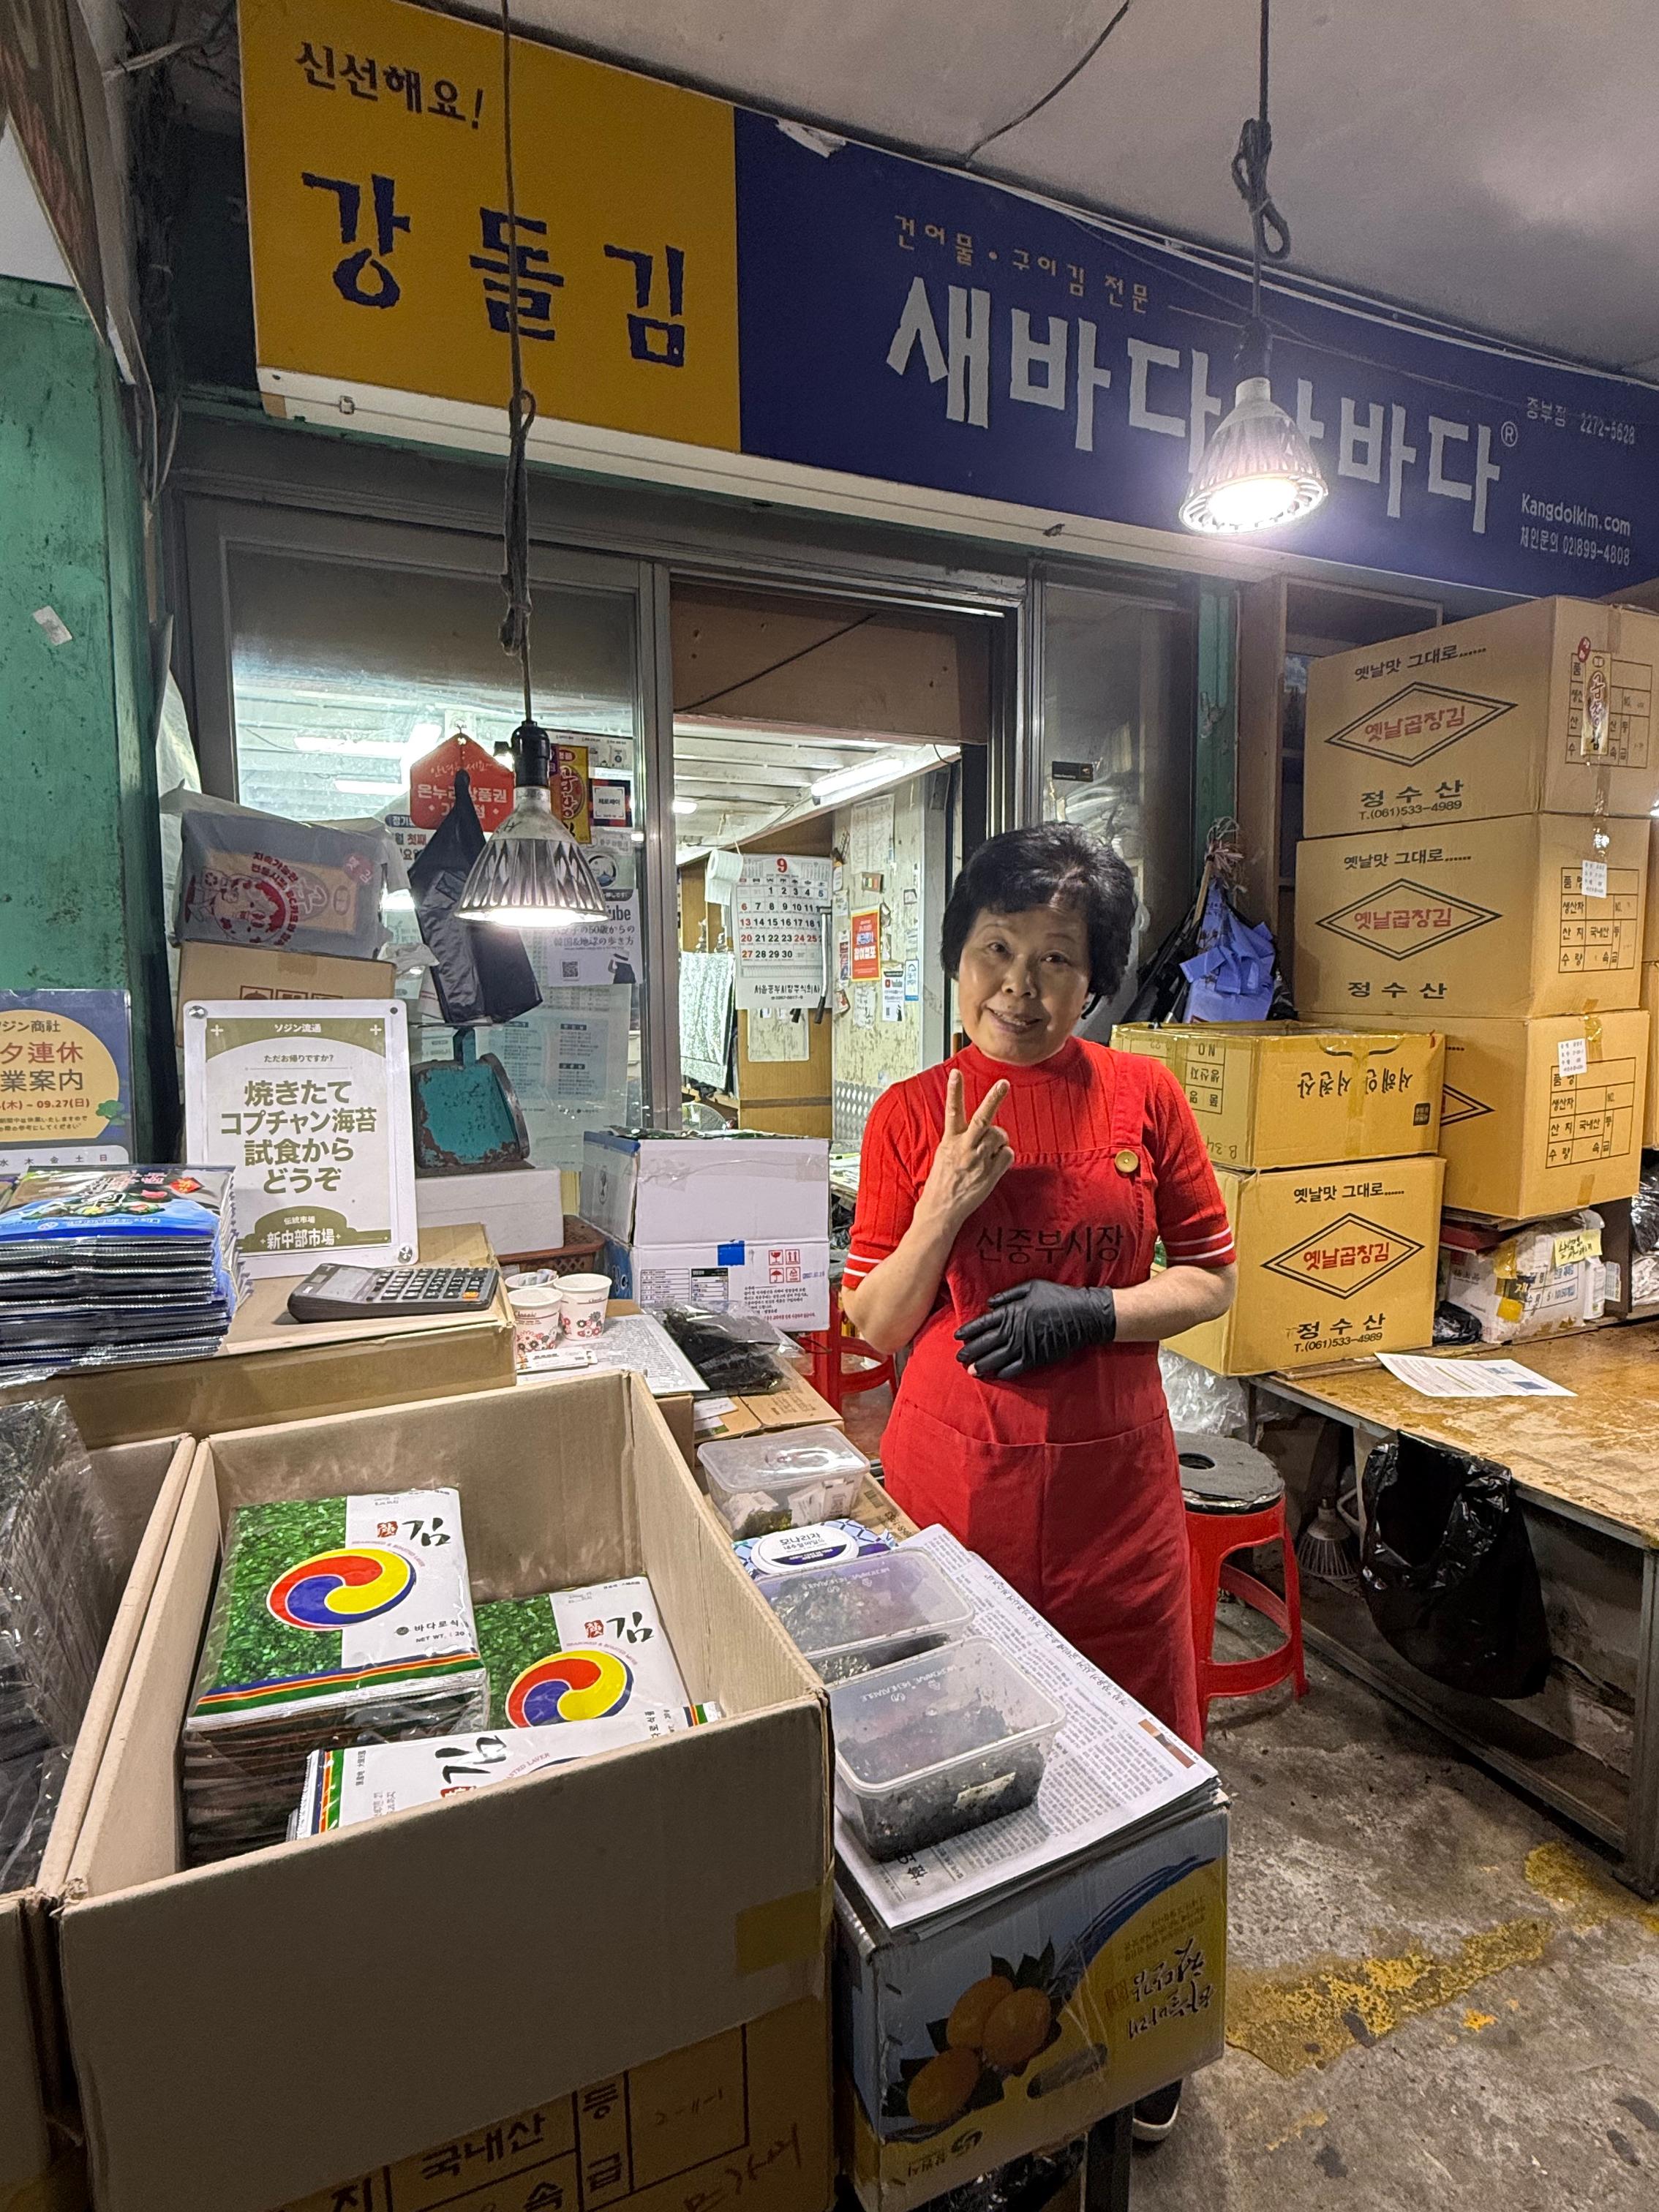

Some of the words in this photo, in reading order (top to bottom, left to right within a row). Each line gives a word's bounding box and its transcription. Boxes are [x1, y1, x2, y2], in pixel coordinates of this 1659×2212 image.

[296, 41, 484, 129] 신선해요!
[1104, 274, 1148, 315] 전문
[886, 276, 1222, 474] 새바다
[1354, 660, 1402, 682] 옛날맛
[1364, 706, 1467, 743] 옛날곱창김
[777, 858, 787, 873] 9
[1344, 854, 1389, 870] 옛날맛
[1353, 907, 1453, 930] 옛날곱창김
[274, 1023, 322, 1034] ソジン流通
[244, 1079, 353, 1107] 焼きたて
[221, 1107, 377, 1136] コプチャン海苔
[99, 1154, 108, 1162] 日
[244, 1136, 355, 1167] 試食から
[263, 1166, 342, 1195] どうぞ
[1293, 1185, 1338, 1204] 옛날맛
[283, 1215, 316, 1225] 伝統市場
[266, 1227, 336, 1250] 新中部市場
[975, 1224, 1124, 1265] 신중부시장
[1303, 1241, 1391, 1271] 옛날곱창김
[1294, 1332, 1383, 1353] T.(061)533-4989
[402, 1516, 451, 1547] 김
[606, 1611, 655, 1644] 김
[434, 1734, 508, 1785] 김
[421, 2110, 547, 2181] 국내산
